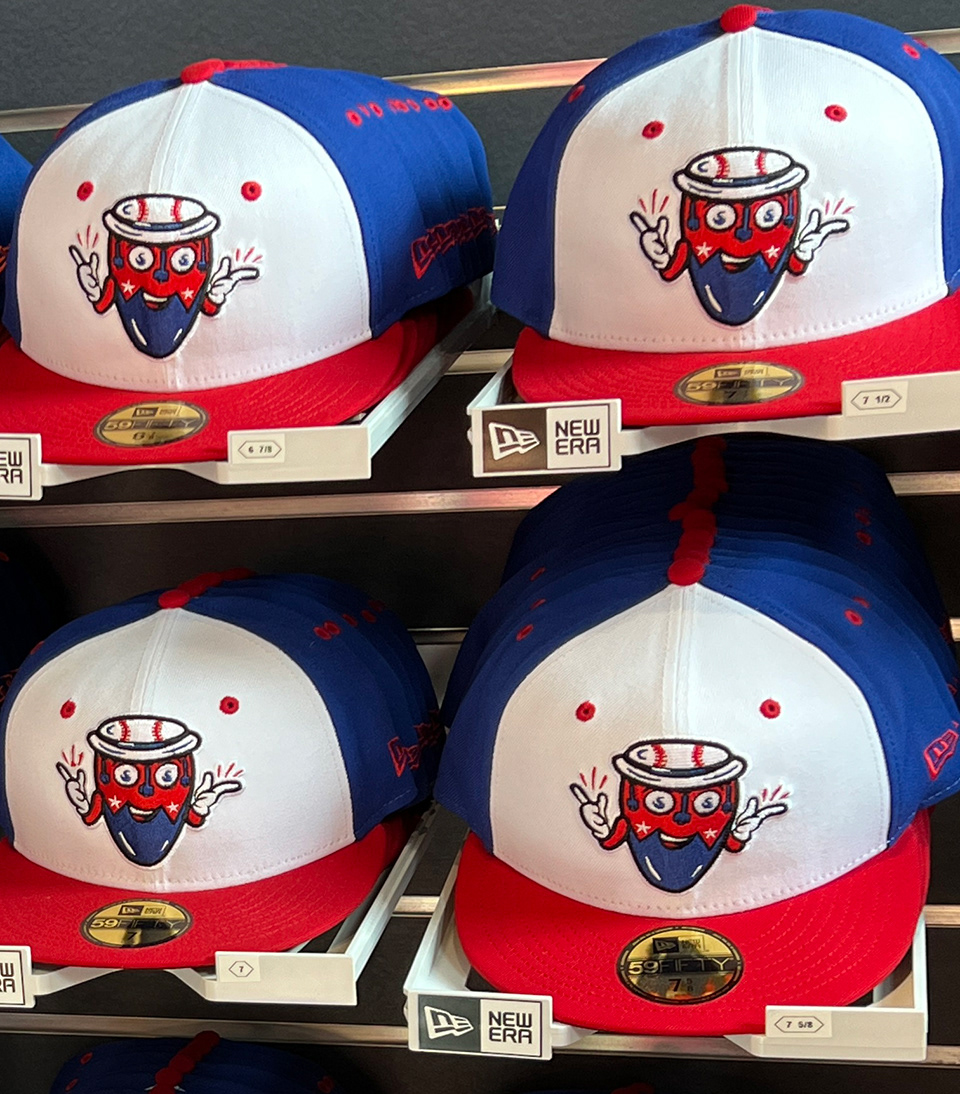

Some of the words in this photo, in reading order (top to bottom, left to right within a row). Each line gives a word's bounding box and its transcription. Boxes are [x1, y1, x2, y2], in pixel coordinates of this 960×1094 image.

[555, 419, 600, 438] NEW
[555, 437, 600, 455] ERA
[488, 1011, 533, 1028] NEW
[489, 1027, 533, 1044] ERA
